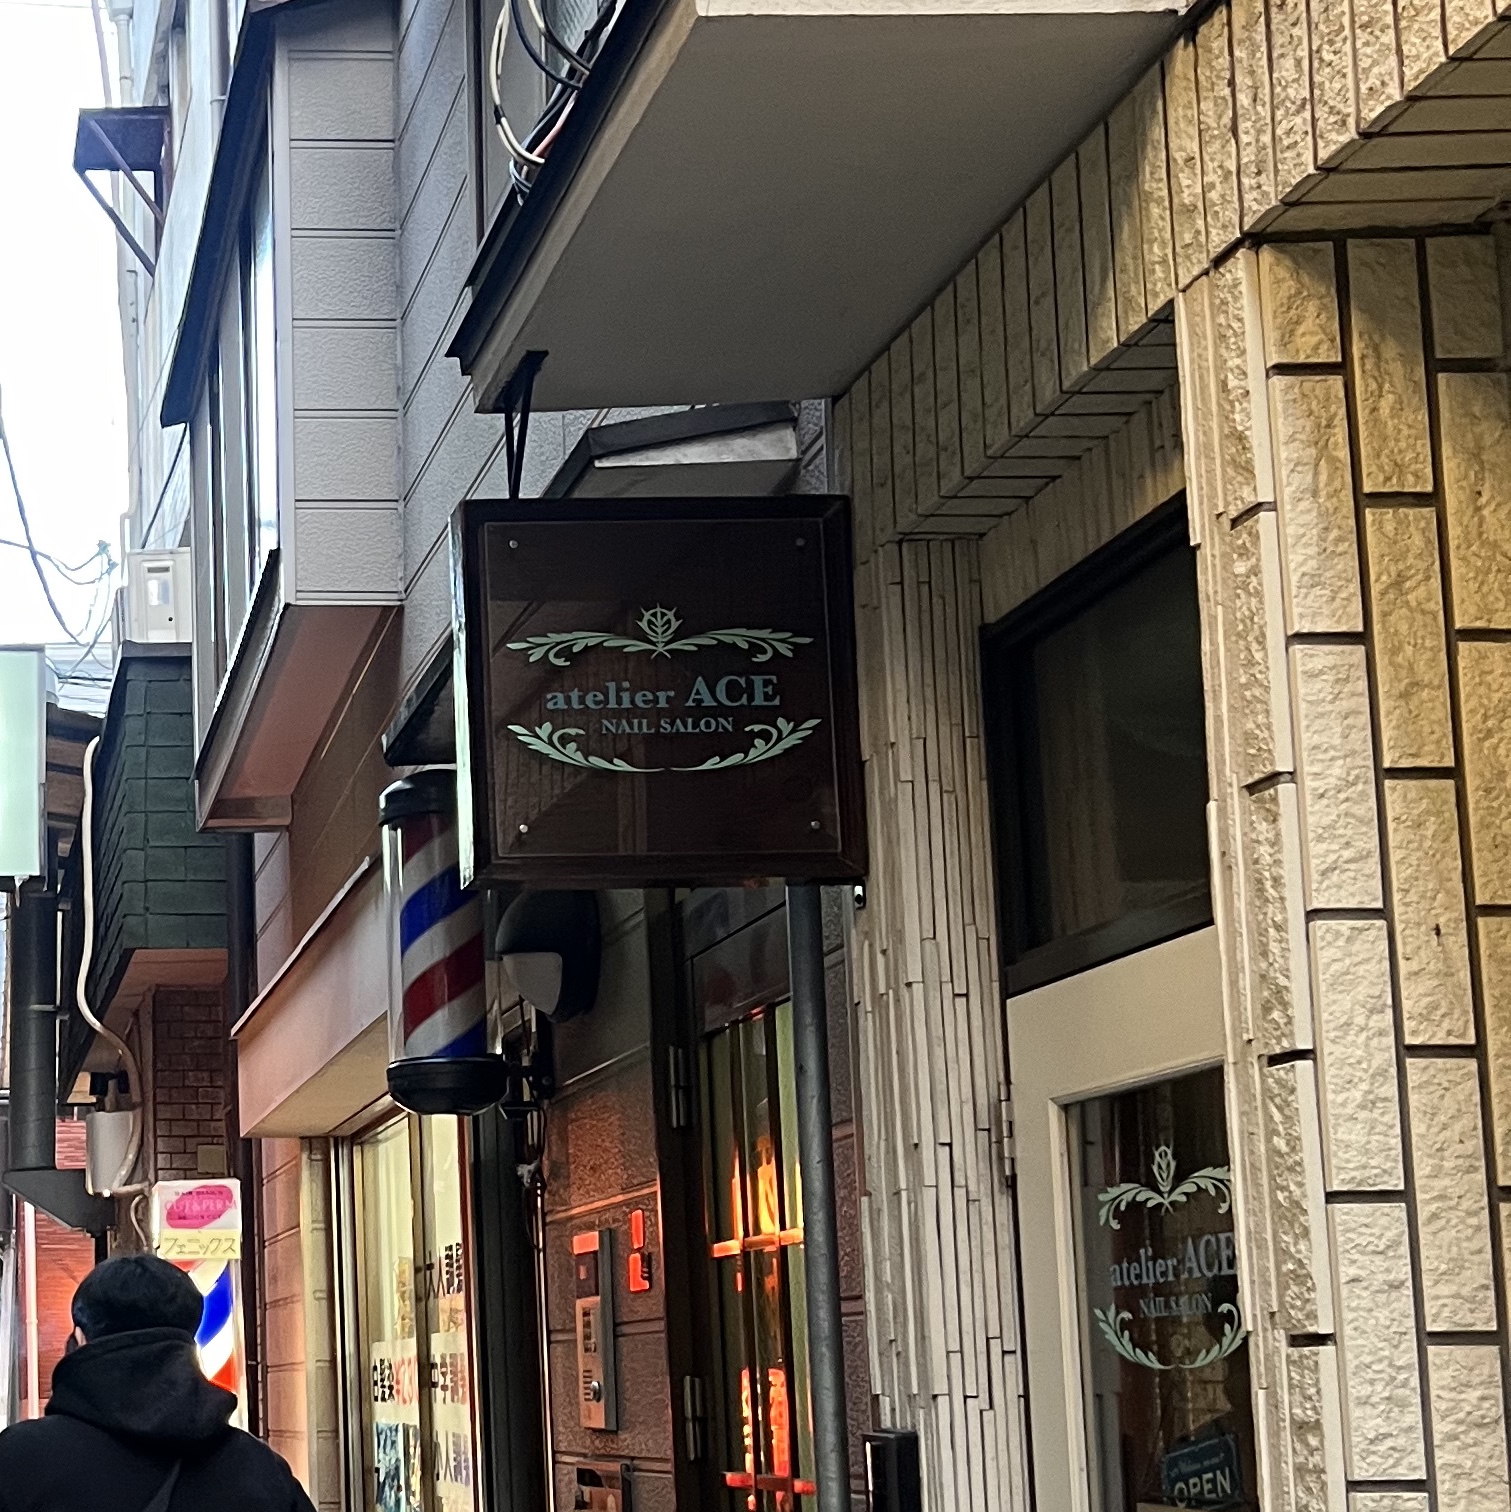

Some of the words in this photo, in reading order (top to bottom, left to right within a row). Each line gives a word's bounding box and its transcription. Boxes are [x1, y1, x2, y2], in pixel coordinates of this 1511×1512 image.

[545, 681, 675, 711] atelier
[684, 675, 781, 707] ACE
[601, 718, 656, 735] NAIL
[659, 717, 734, 733] SALON
[163, 1236, 236, 1256] フェニックス
[1109, 1247, 1178, 1288] atelier
[1180, 1232, 1238, 1280] ACE
[1173, 1467, 1232, 1508] OPEN
